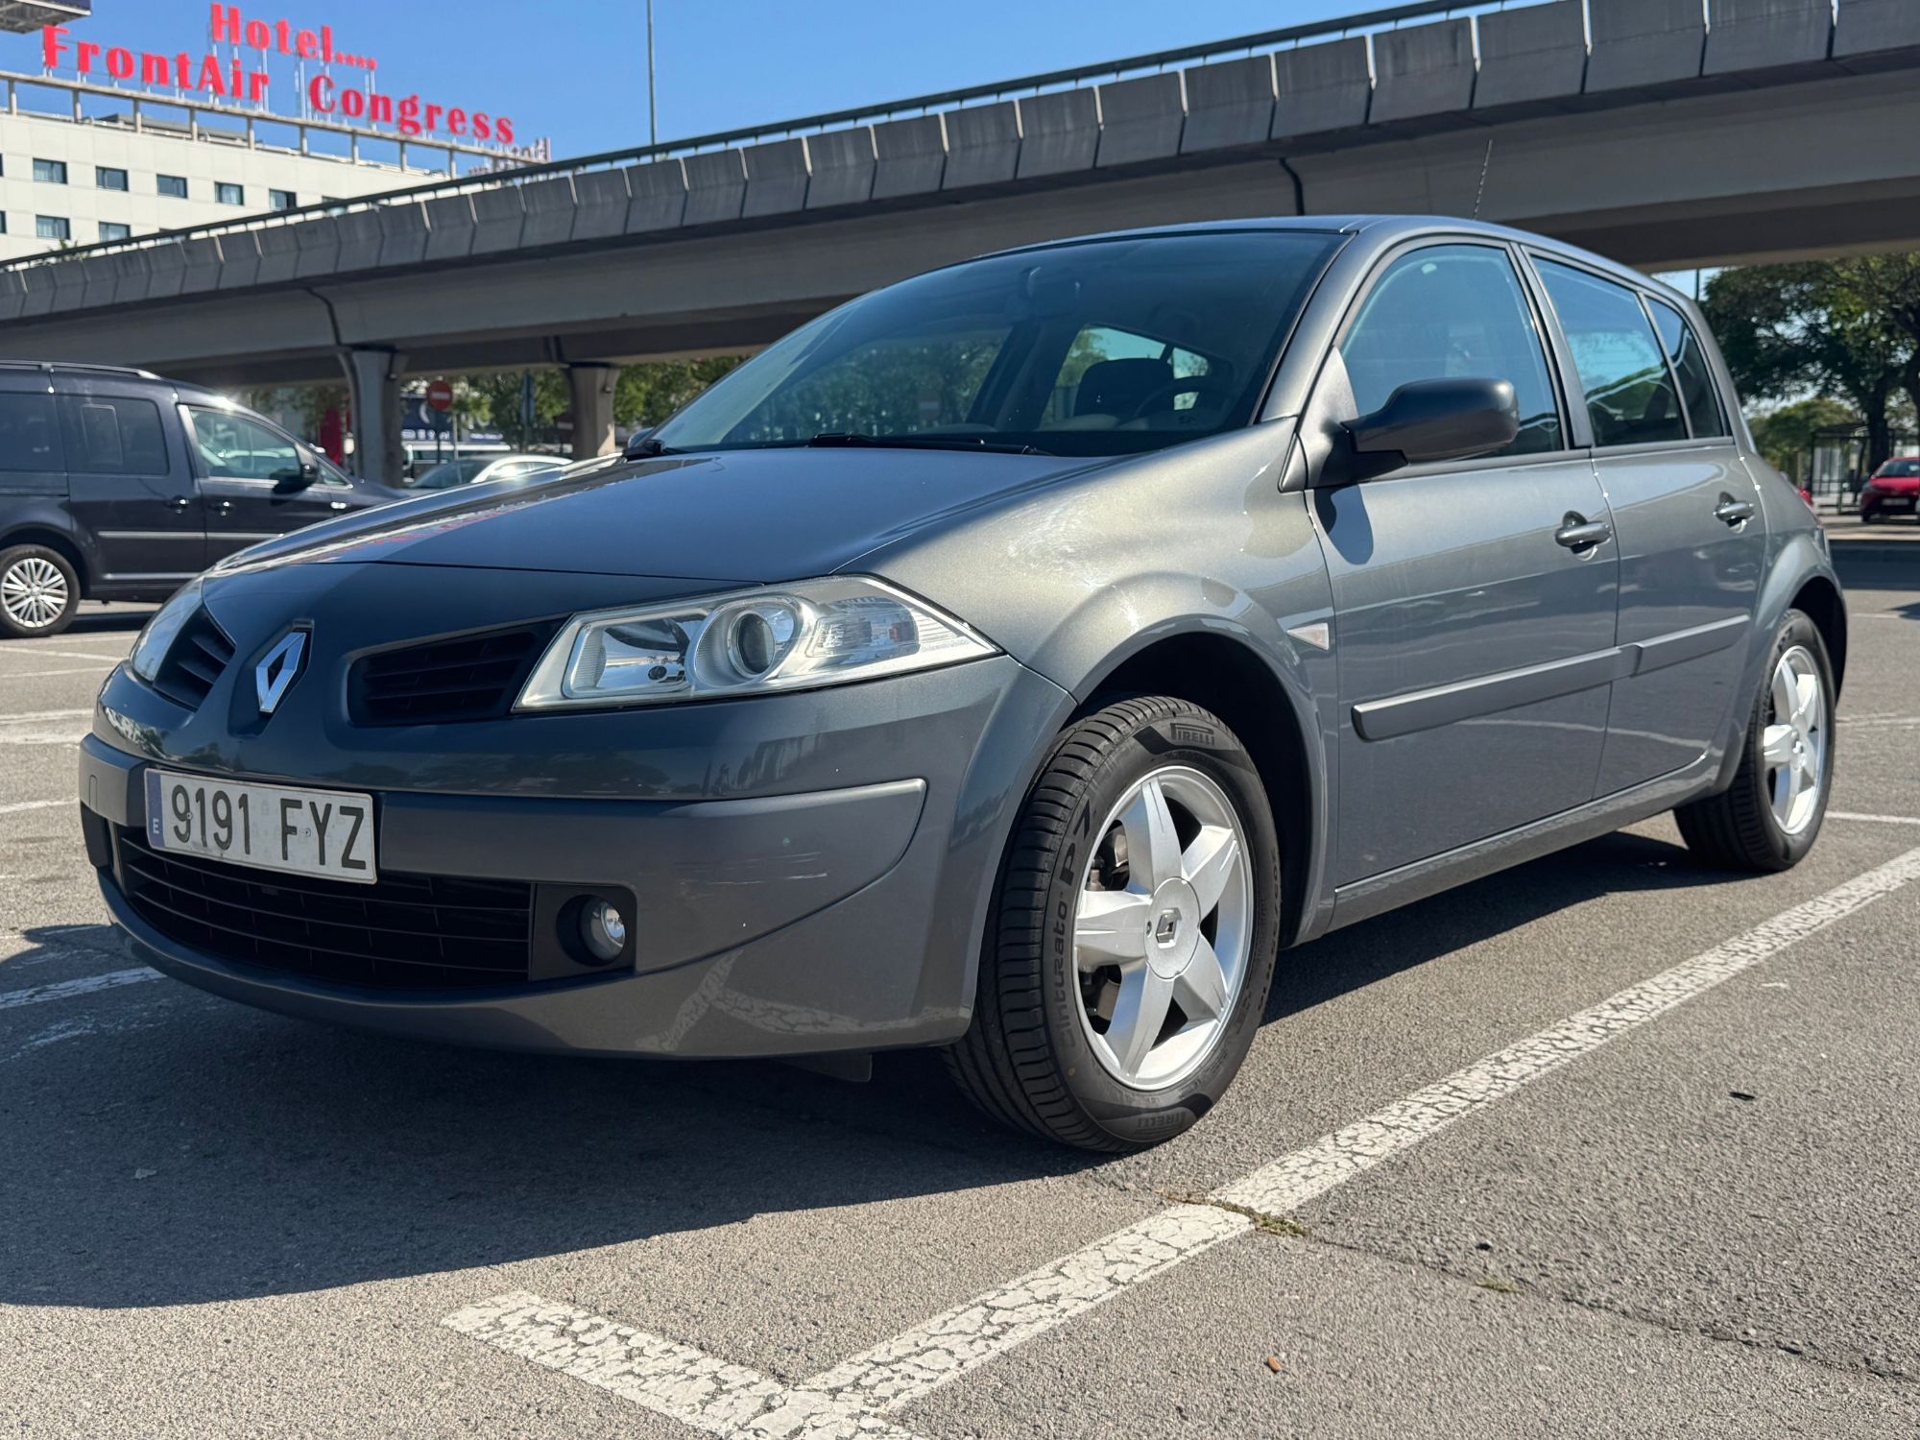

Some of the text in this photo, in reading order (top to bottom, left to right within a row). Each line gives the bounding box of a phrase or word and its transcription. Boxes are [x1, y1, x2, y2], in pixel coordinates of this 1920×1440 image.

[308, 74, 514, 144] Congress
[1169, 722, 1215, 747] PIRELLI
[152, 818, 160, 834] E
[171, 784, 367, 870] 9191 FYZ
[1059, 798, 1091, 887] P7
